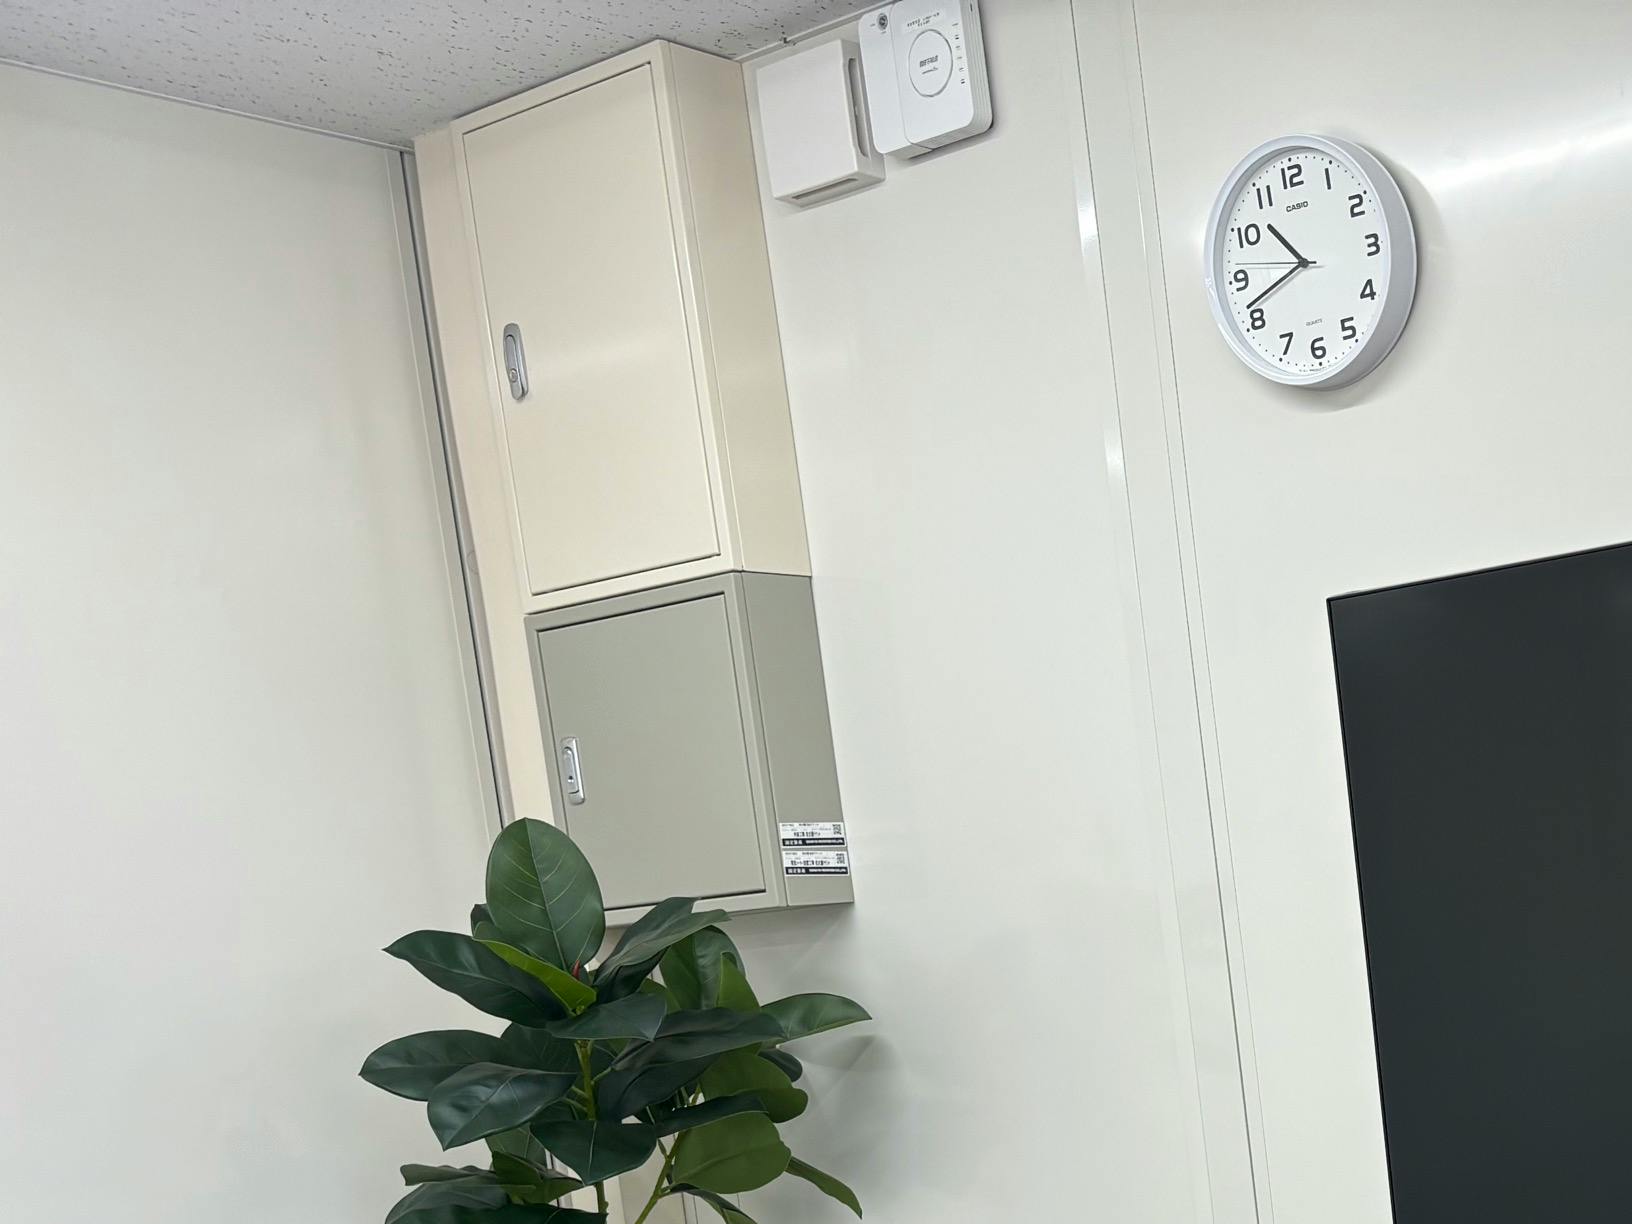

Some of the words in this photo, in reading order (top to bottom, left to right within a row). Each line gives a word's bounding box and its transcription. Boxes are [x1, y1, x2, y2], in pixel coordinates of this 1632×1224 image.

[1281, 163, 1304, 190] 12
[1324, 167, 1332, 190] 1
[1256, 185, 1274, 209] 11
[1286, 200, 1309, 212] CASIO
[1348, 193, 1366, 218] 2
[1237, 223, 1261, 248] 10
[1364, 233, 1381, 257] 3
[1233, 269, 1249, 292] 9
[1359, 278, 1376, 300] 4
[1249, 308, 1266, 330] 8
[1340, 316, 1357, 340] 5
[1279, 331, 1294, 356] 7
[1310, 336, 1327, 360] 6
